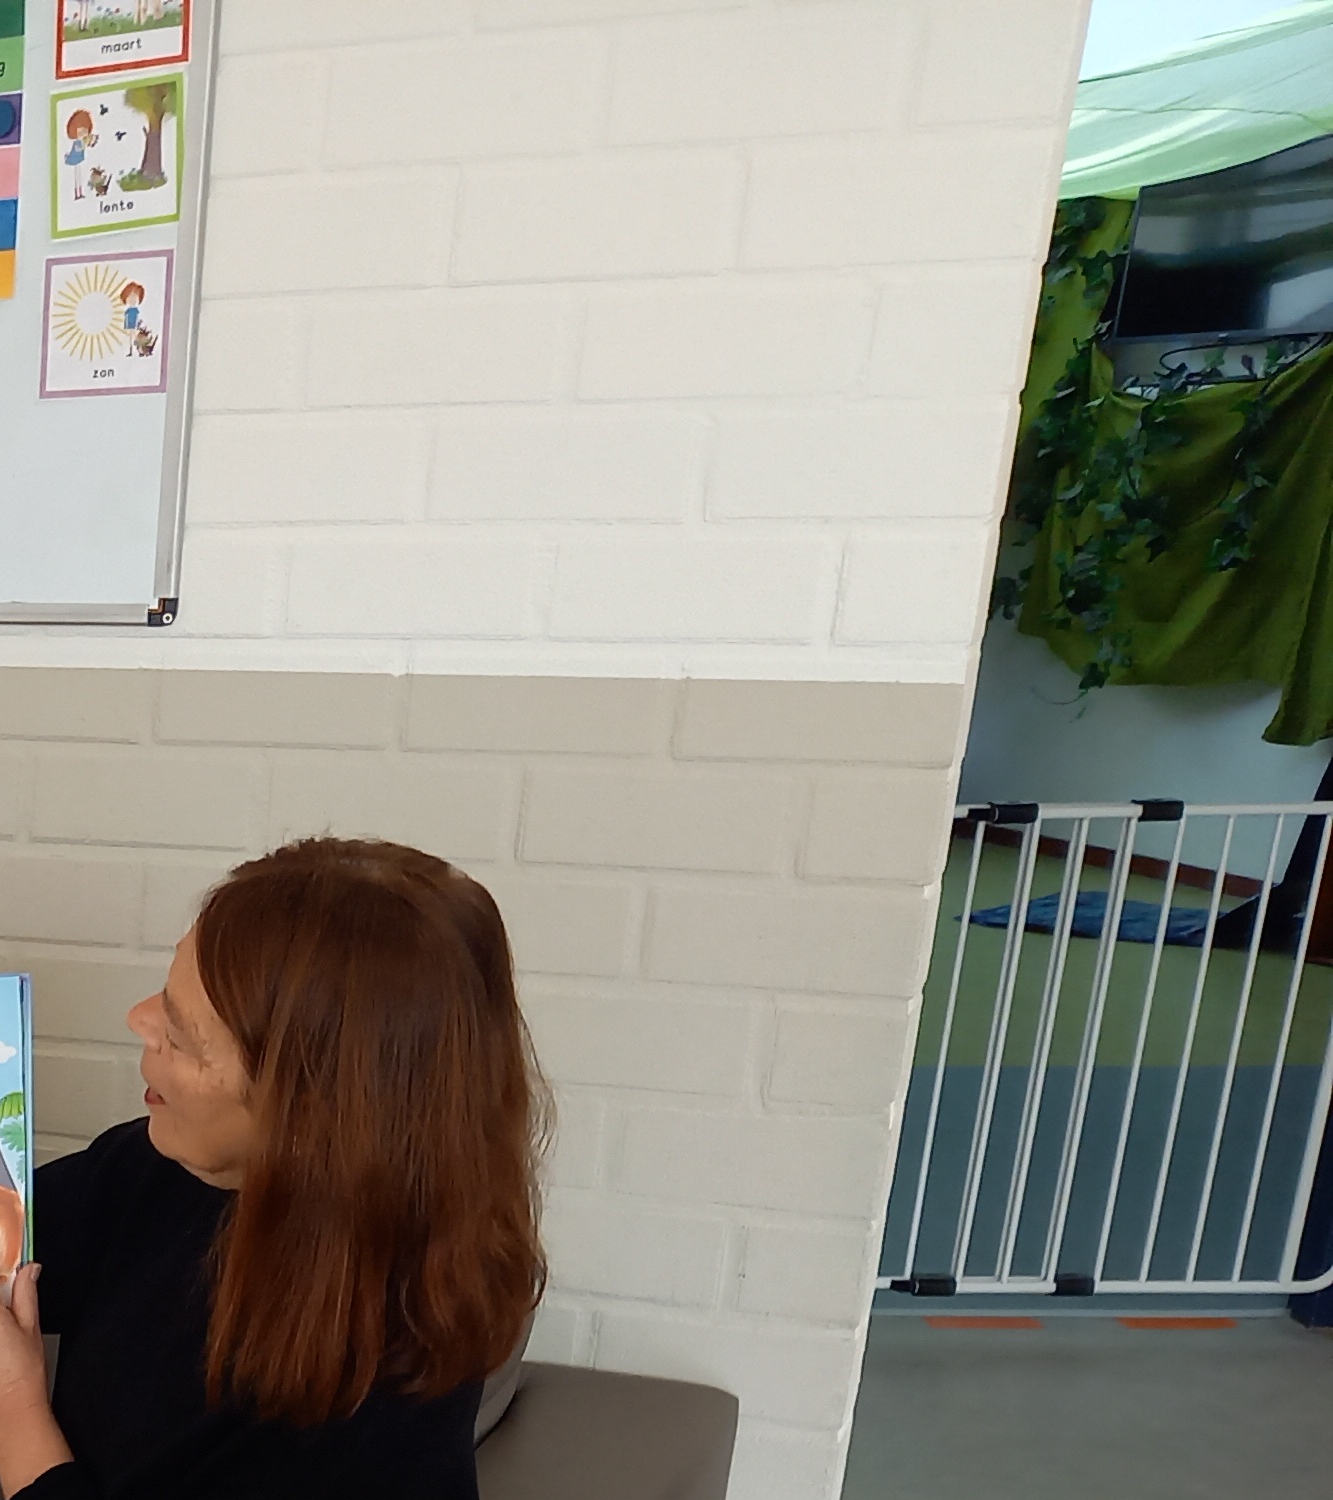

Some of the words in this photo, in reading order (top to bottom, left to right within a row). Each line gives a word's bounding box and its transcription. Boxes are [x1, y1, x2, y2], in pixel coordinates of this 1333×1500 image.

[101, 38, 142, 54] maart
[99, 200, 134, 214] lente
[92, 369, 115, 379] zon
